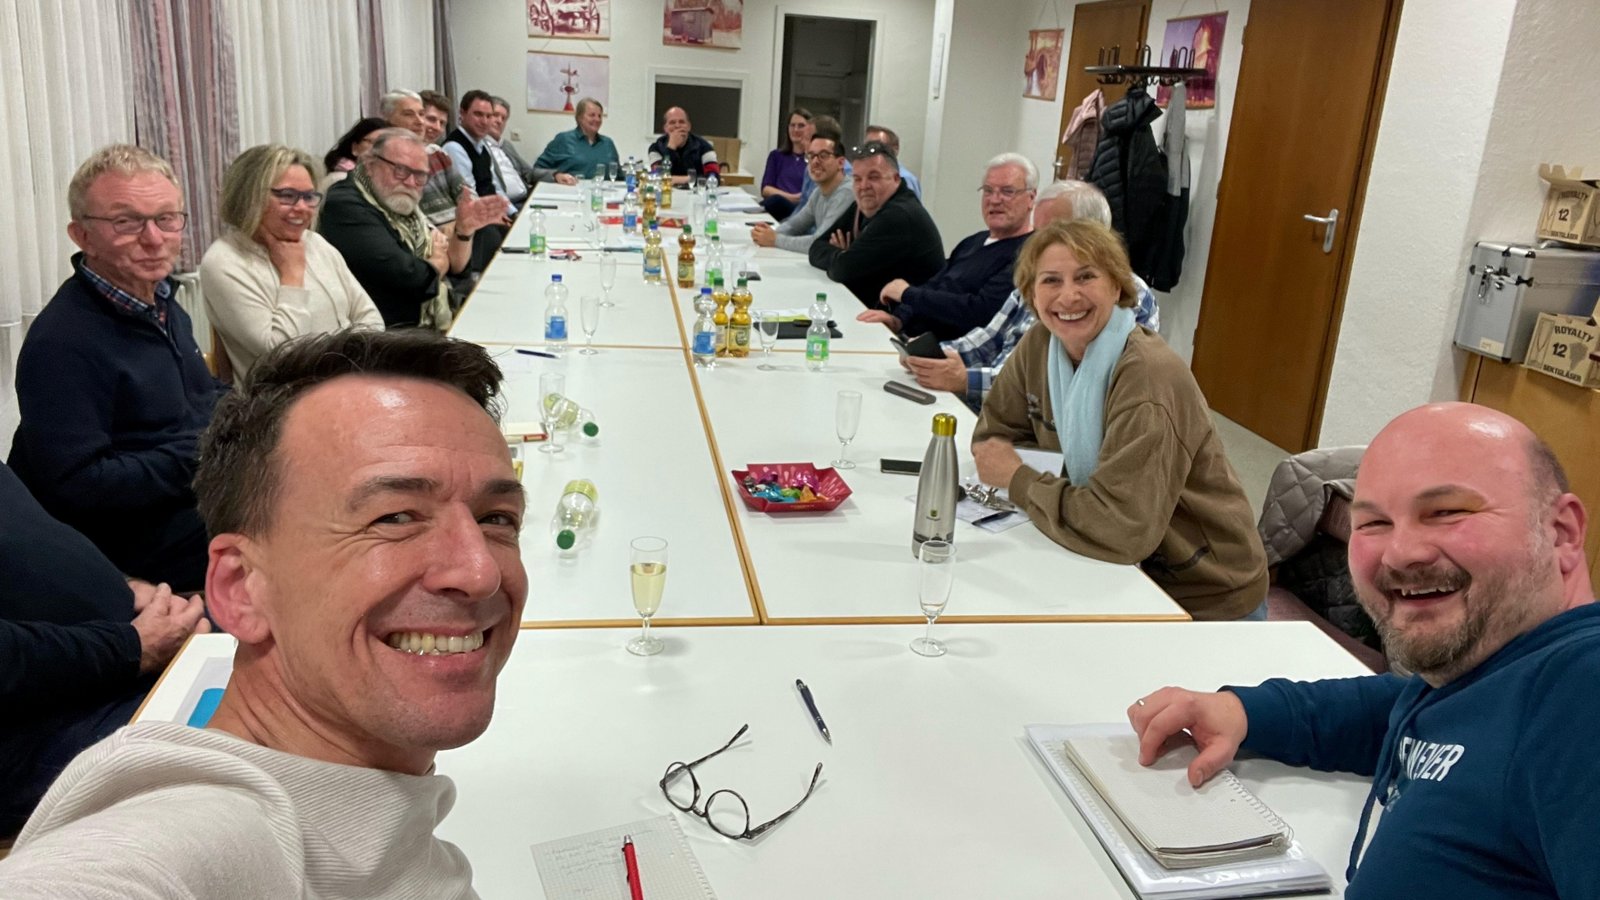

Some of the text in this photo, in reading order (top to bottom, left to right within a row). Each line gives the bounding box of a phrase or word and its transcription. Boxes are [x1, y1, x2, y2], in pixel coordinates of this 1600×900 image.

[1558, 208, 1570, 221] 12
[1554, 325, 1594, 342] ROYALTY
[1552, 342, 1568, 358] 12
